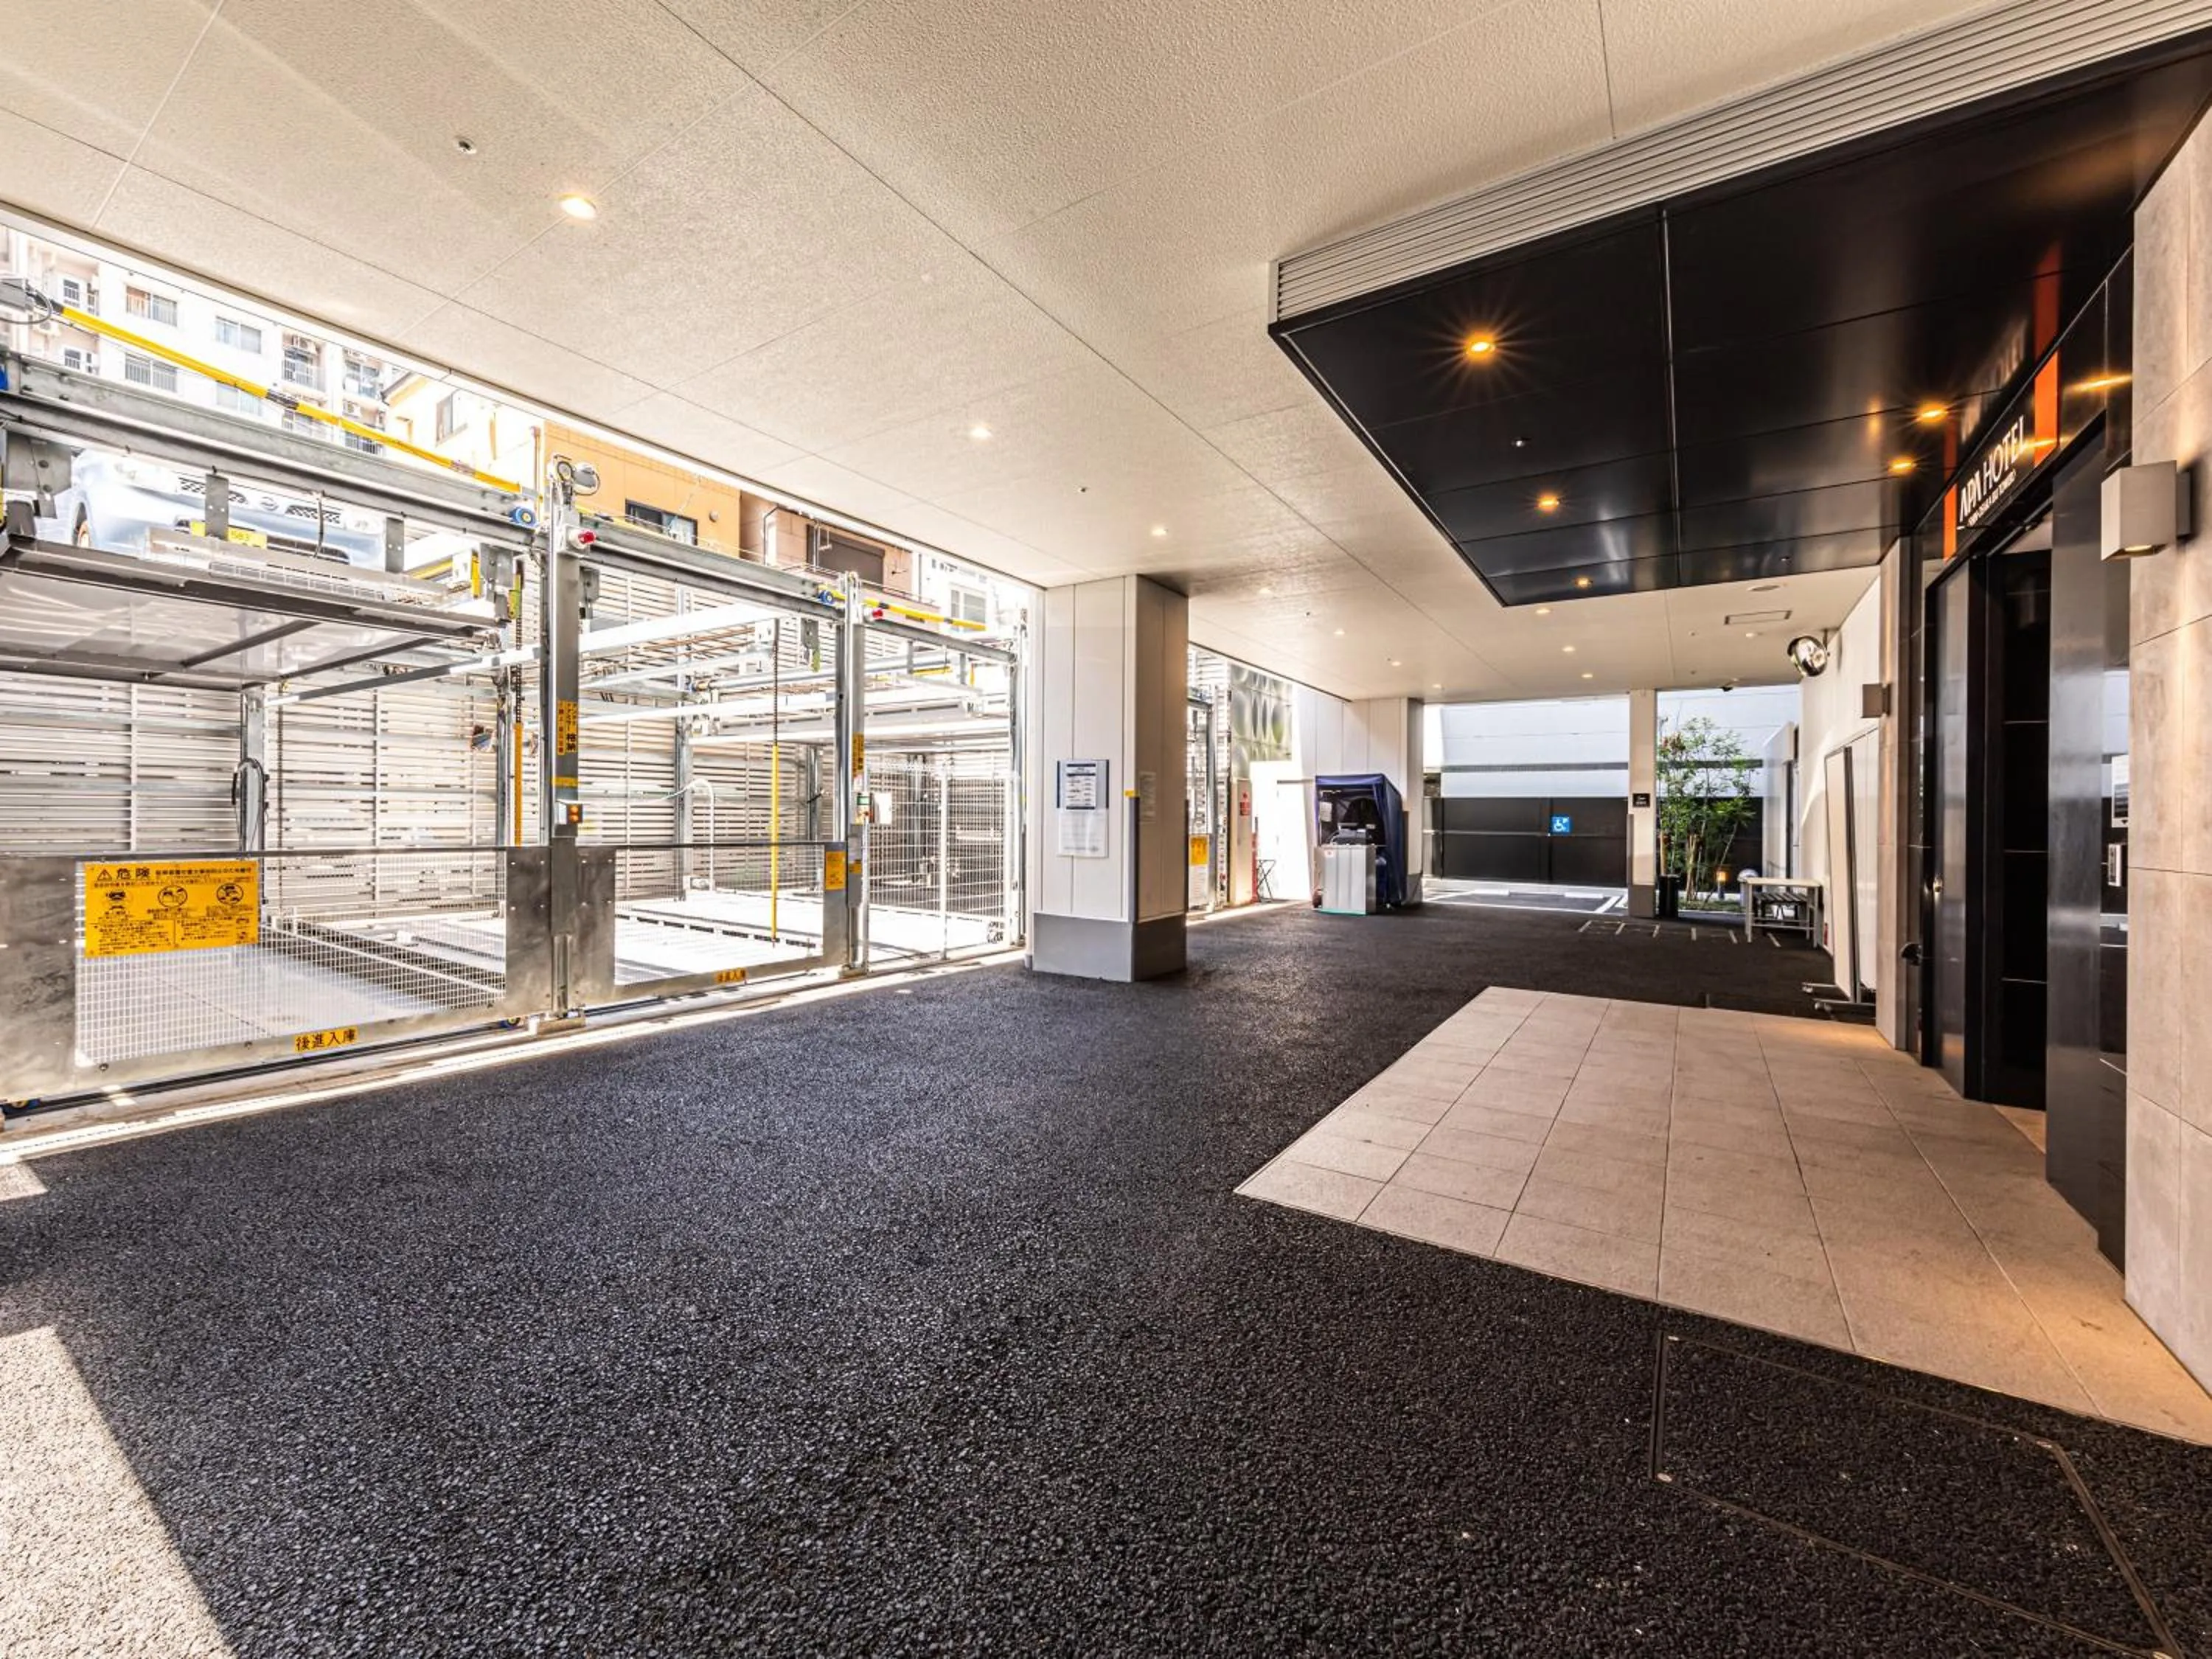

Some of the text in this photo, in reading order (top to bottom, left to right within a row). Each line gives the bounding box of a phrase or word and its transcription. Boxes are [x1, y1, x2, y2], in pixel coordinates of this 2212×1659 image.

[1959, 470, 1982, 522] APA
[1983, 414, 2025, 495] HOTEL
[116, 867, 150, 880] 危険
[296, 1029, 356, 1051] 後進入庫
